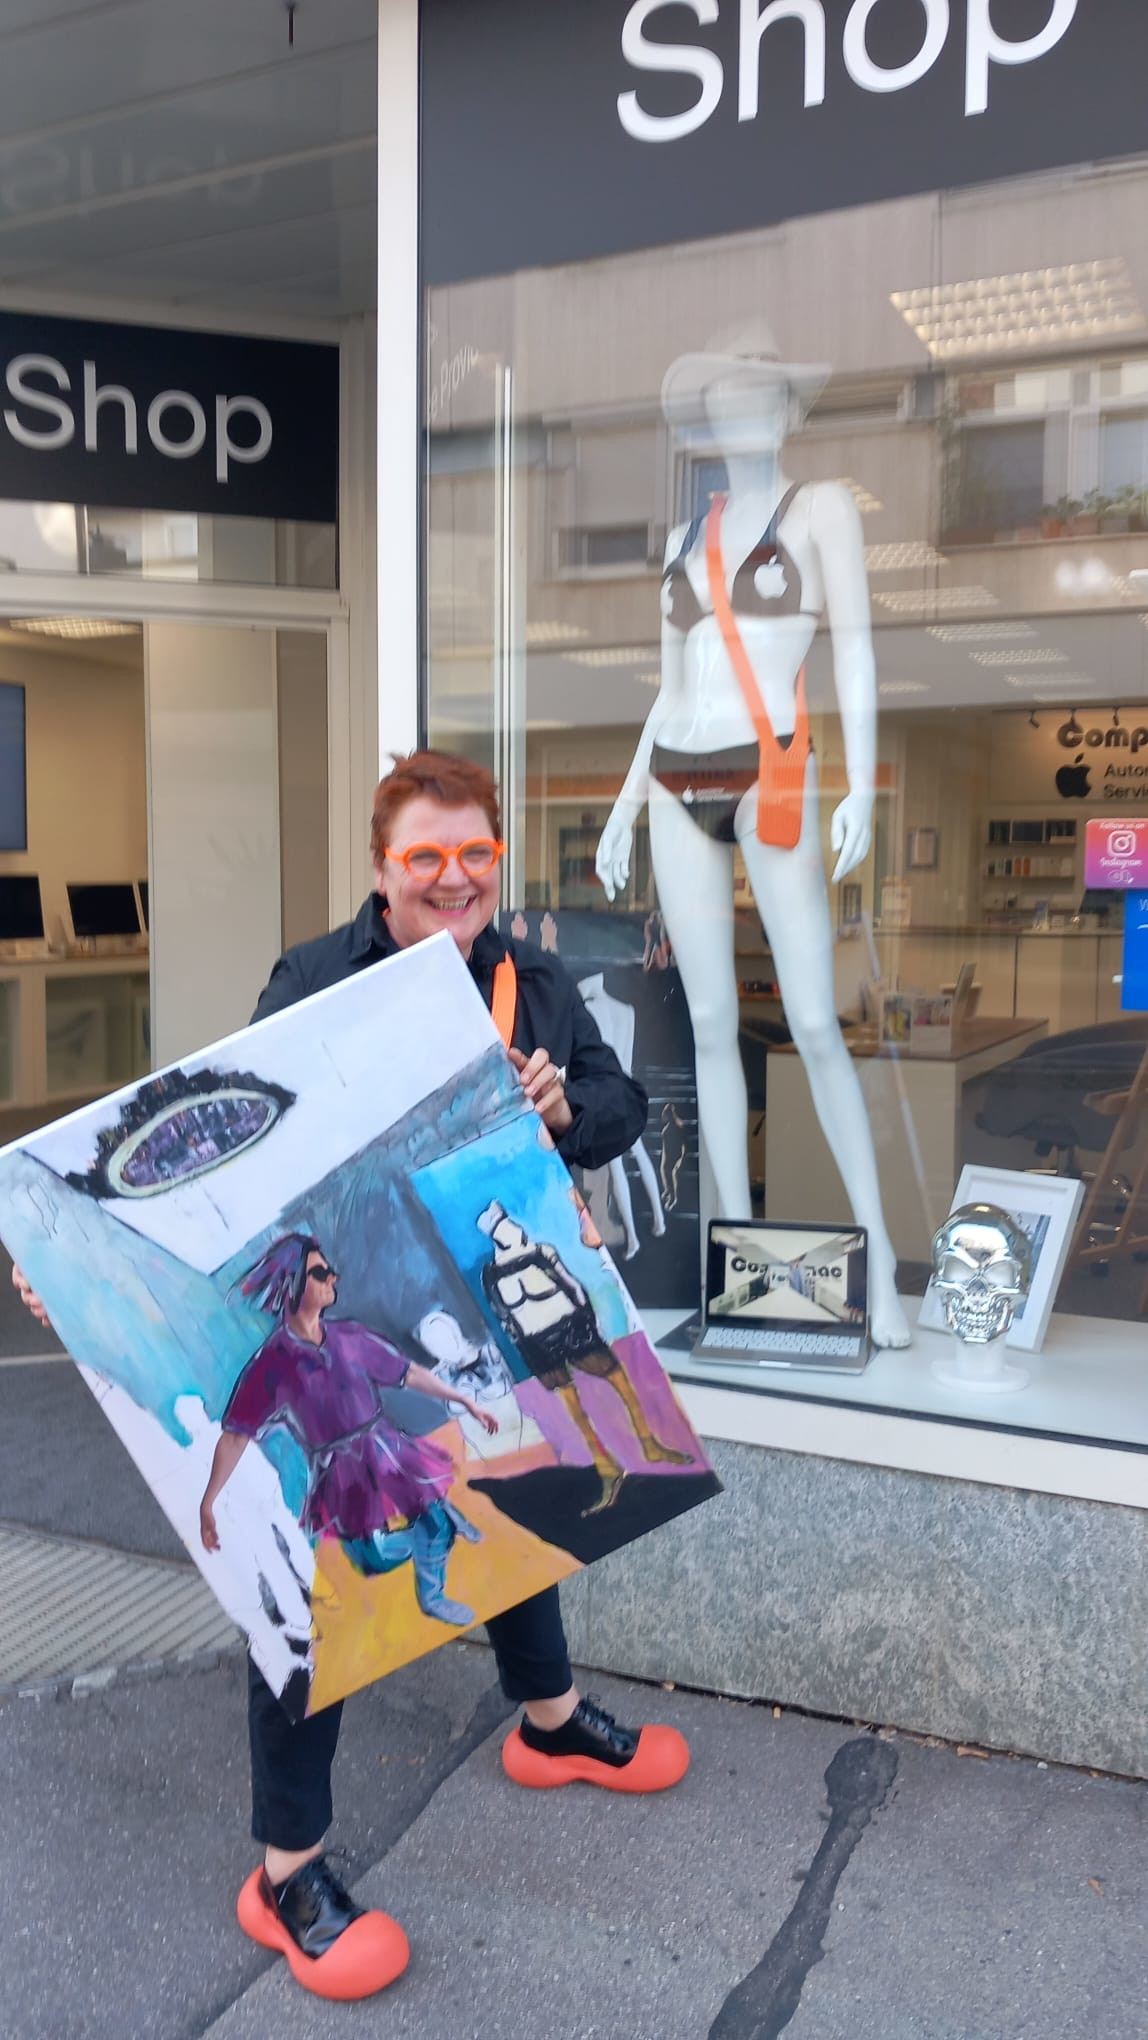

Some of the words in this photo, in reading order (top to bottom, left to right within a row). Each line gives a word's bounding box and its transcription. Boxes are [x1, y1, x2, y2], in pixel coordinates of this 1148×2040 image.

[617, 0, 1078, 143] Shop
[3, 353, 273, 483] Shop
[1103, 784, 1148, 800] Servi
[1100, 857, 1142, 869] Instagram
